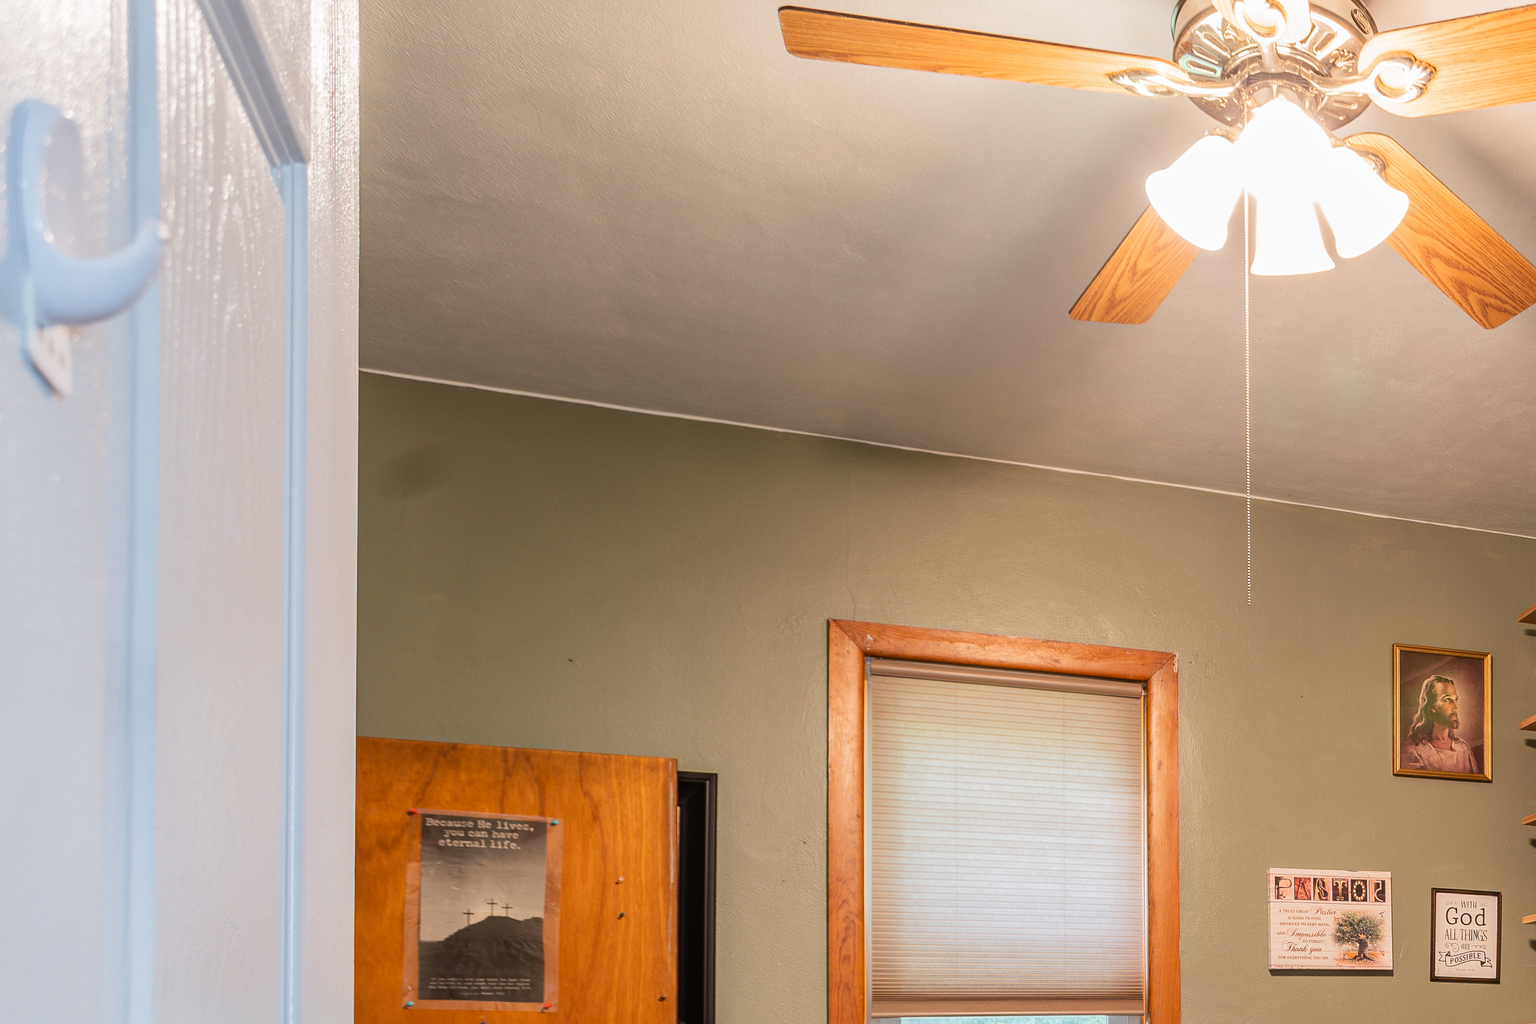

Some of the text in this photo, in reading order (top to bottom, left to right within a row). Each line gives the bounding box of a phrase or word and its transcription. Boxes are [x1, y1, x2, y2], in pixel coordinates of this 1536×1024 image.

[425, 817, 535, 832] Because He lives,
[443, 829, 519, 839] you can have
[438, 838, 521, 850] eternal life.
[1275, 876, 1386, 903] PASTOR
[1461, 900, 1478, 909] WITH
[1311, 906, 1336, 916] Pastor
[1446, 907, 1487, 926] God
[1287, 928, 1326, 940] Impossible
[1444, 928, 1488, 942] ALL THINGS
[1281, 940, 1309, 952] Thank
[1449, 952, 1482, 965] POSSIBLE
